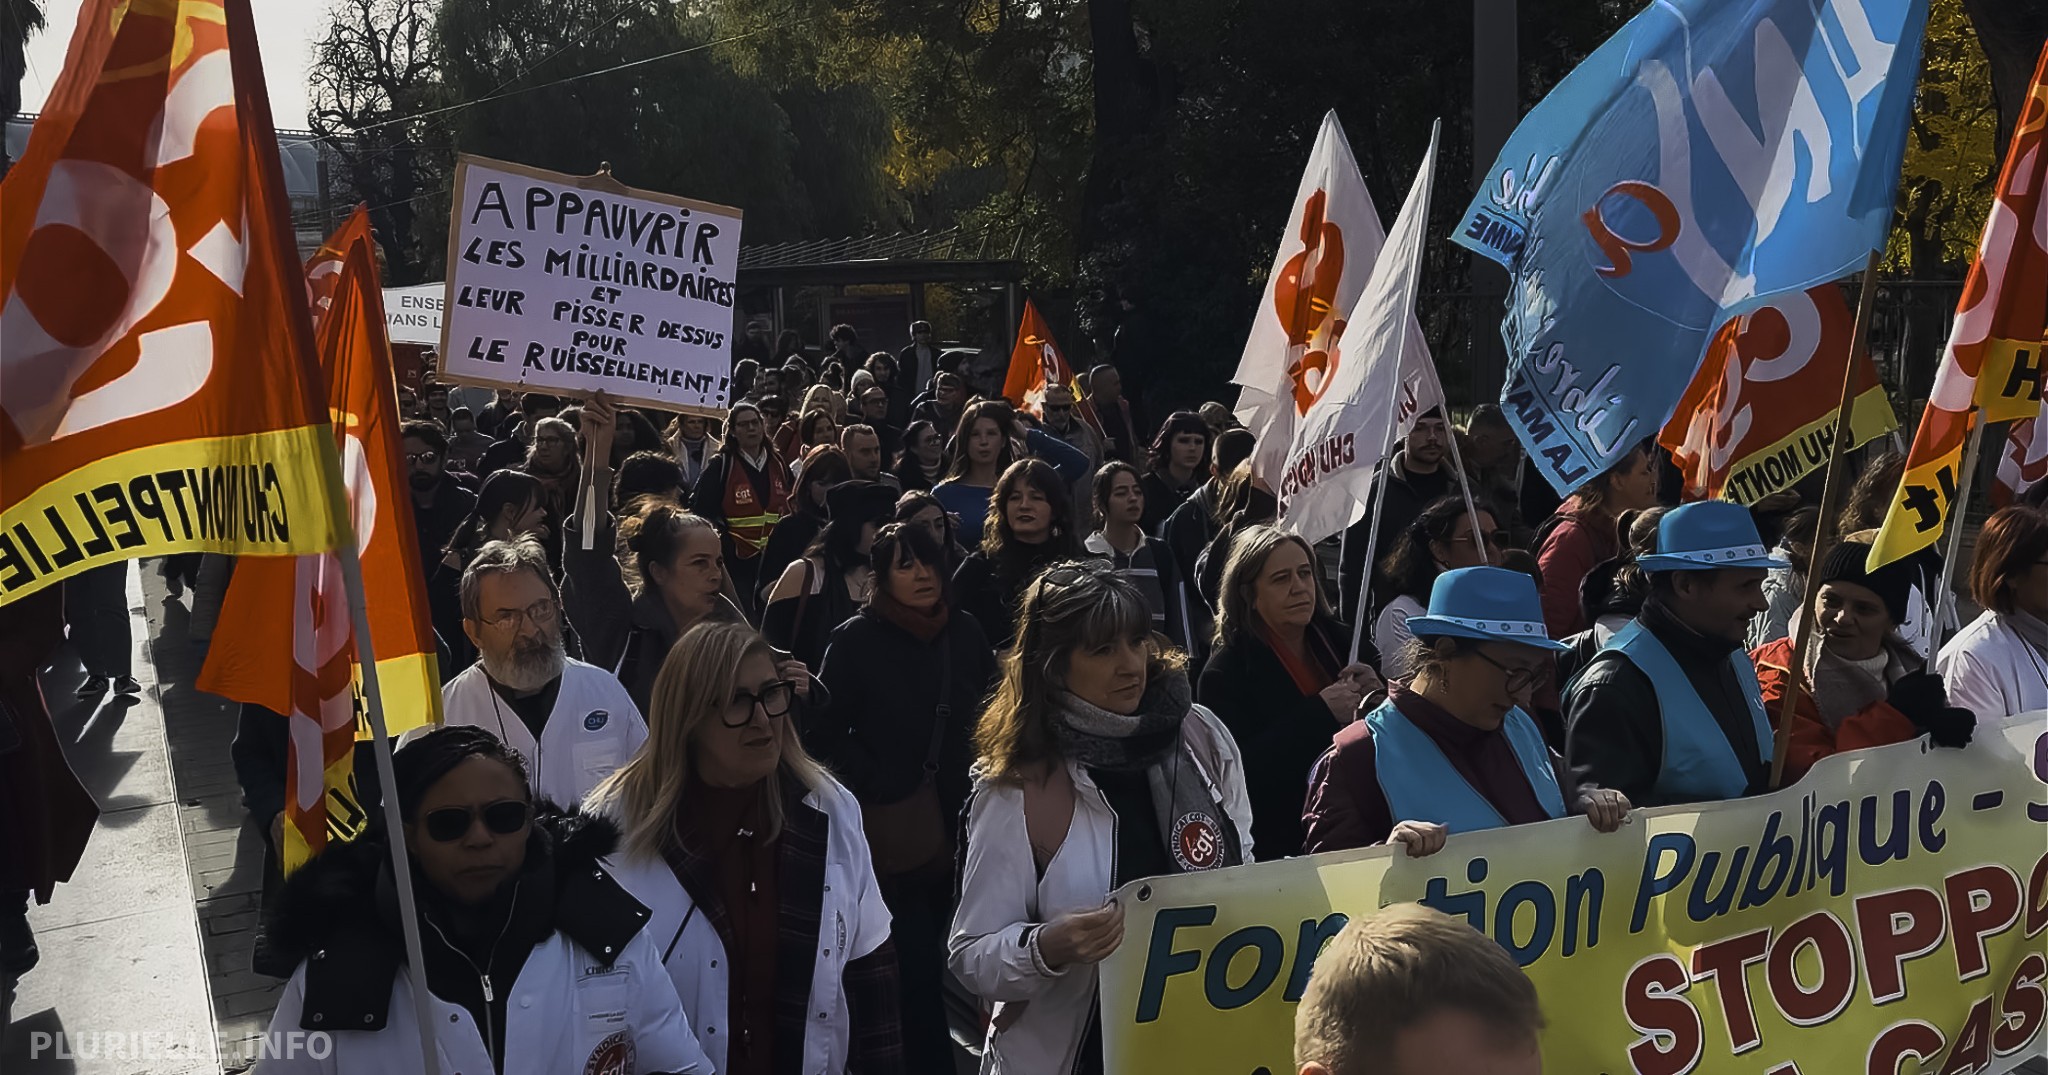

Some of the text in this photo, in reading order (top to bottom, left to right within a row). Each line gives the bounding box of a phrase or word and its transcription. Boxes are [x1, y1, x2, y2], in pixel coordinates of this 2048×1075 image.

[471, 182, 720, 265] APPAUVRIR
[463, 236, 735, 307] LES MILLIARDAIRES
[590, 286, 622, 304] ET
[388, 313, 428, 327] ANS
[456, 285, 724, 350] LEUR PISSER DESSUS
[468, 336, 510, 362] LE
[572, 330, 627, 356] POUR
[1191, 828, 1214, 862] cgt
[1135, 857, 1606, 1024] Fontion
[1629, 780, 1947, 933] Publique
